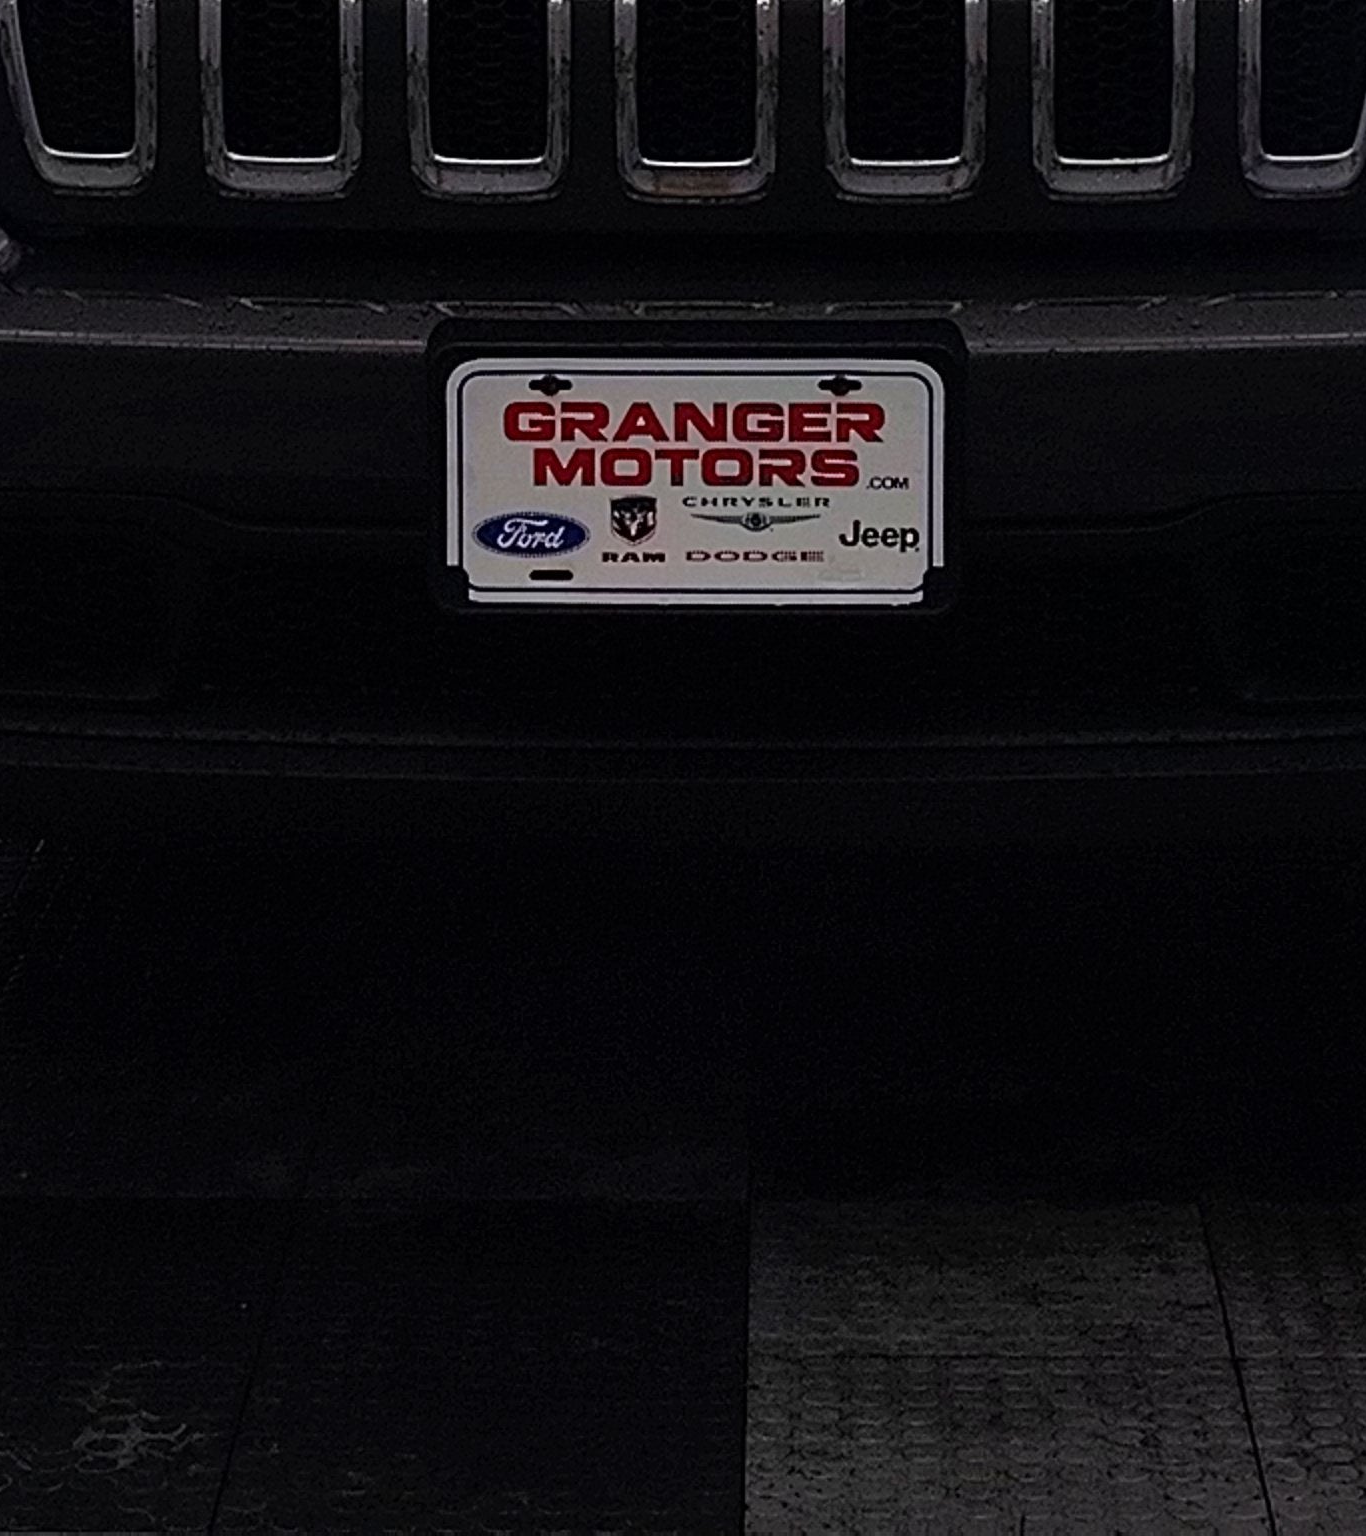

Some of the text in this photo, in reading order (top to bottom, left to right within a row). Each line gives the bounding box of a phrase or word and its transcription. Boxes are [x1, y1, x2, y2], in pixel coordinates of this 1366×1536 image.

[502, 401, 886, 443] GRANGER
[532, 447, 910, 490] MOTORS .COM
[682, 495, 831, 508] CHRYSLER
[496, 517, 566, 549] Ford
[838, 519, 921, 553] Jeep
[601, 551, 666, 563] RAM
[685, 550, 825, 563] DODGE
